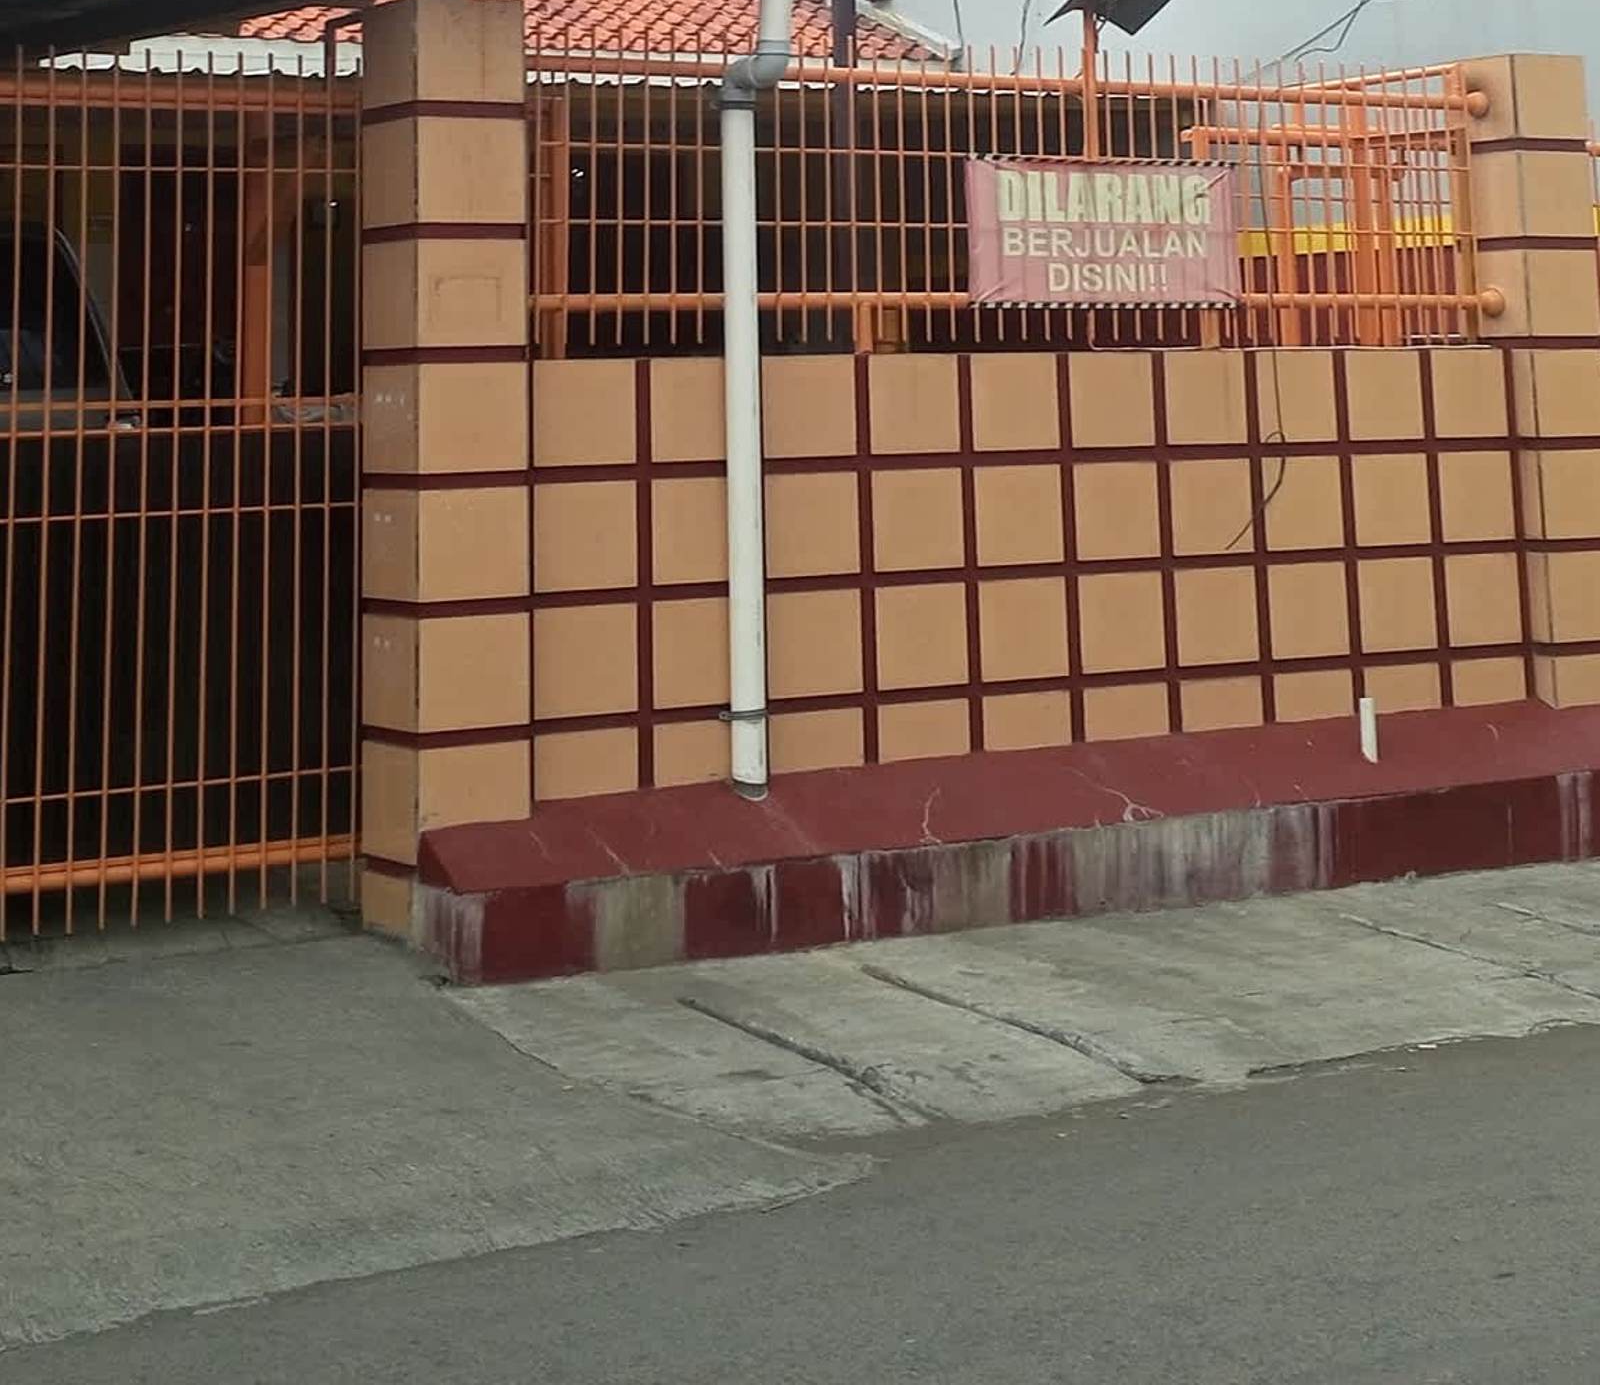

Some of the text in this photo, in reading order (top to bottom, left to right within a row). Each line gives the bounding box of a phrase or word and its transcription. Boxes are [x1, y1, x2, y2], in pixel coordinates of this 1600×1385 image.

[995, 169, 1211, 225] DILARANG
[1002, 227, 1207, 258] BERJUALAN
[1048, 262, 1168, 293] DISINI!!
